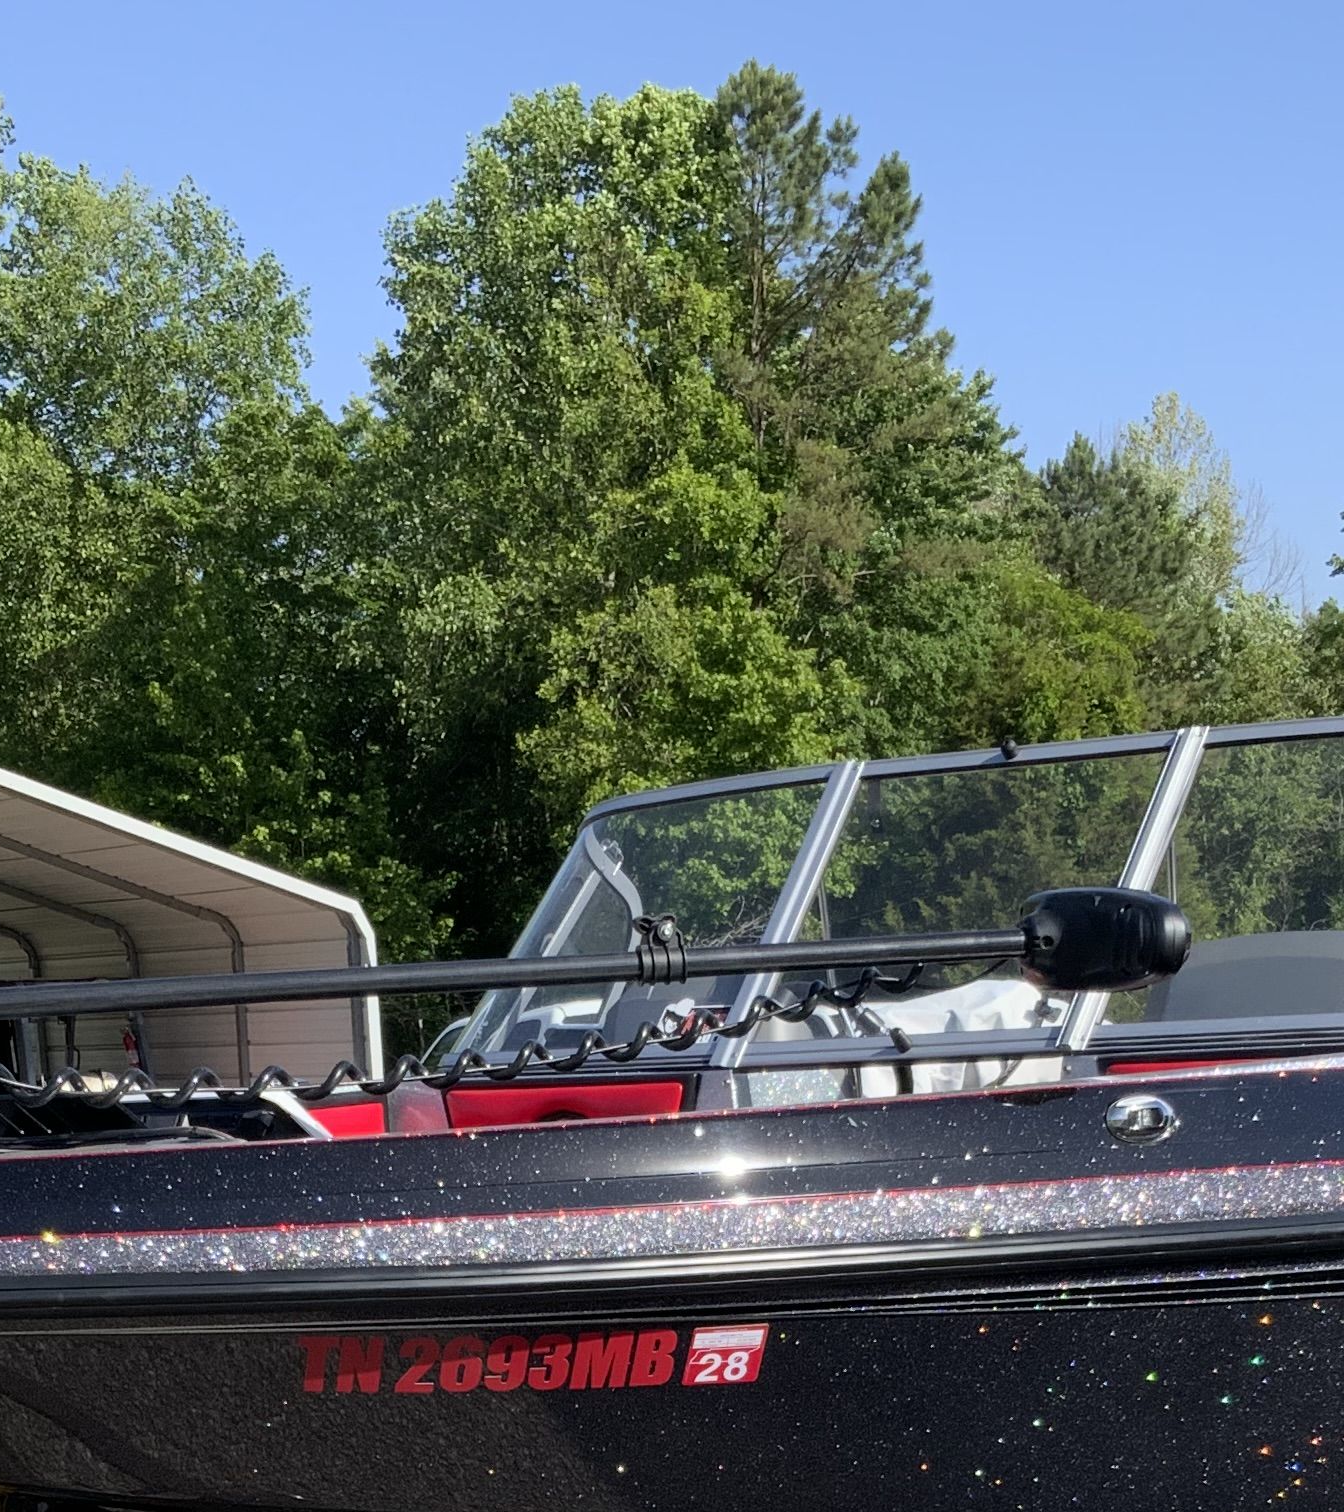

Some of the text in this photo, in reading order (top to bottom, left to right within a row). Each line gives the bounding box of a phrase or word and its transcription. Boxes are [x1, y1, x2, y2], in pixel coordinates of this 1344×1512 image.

[297, 1329, 678, 1393] TN 2693MB
[694, 1351, 750, 1383] 28
